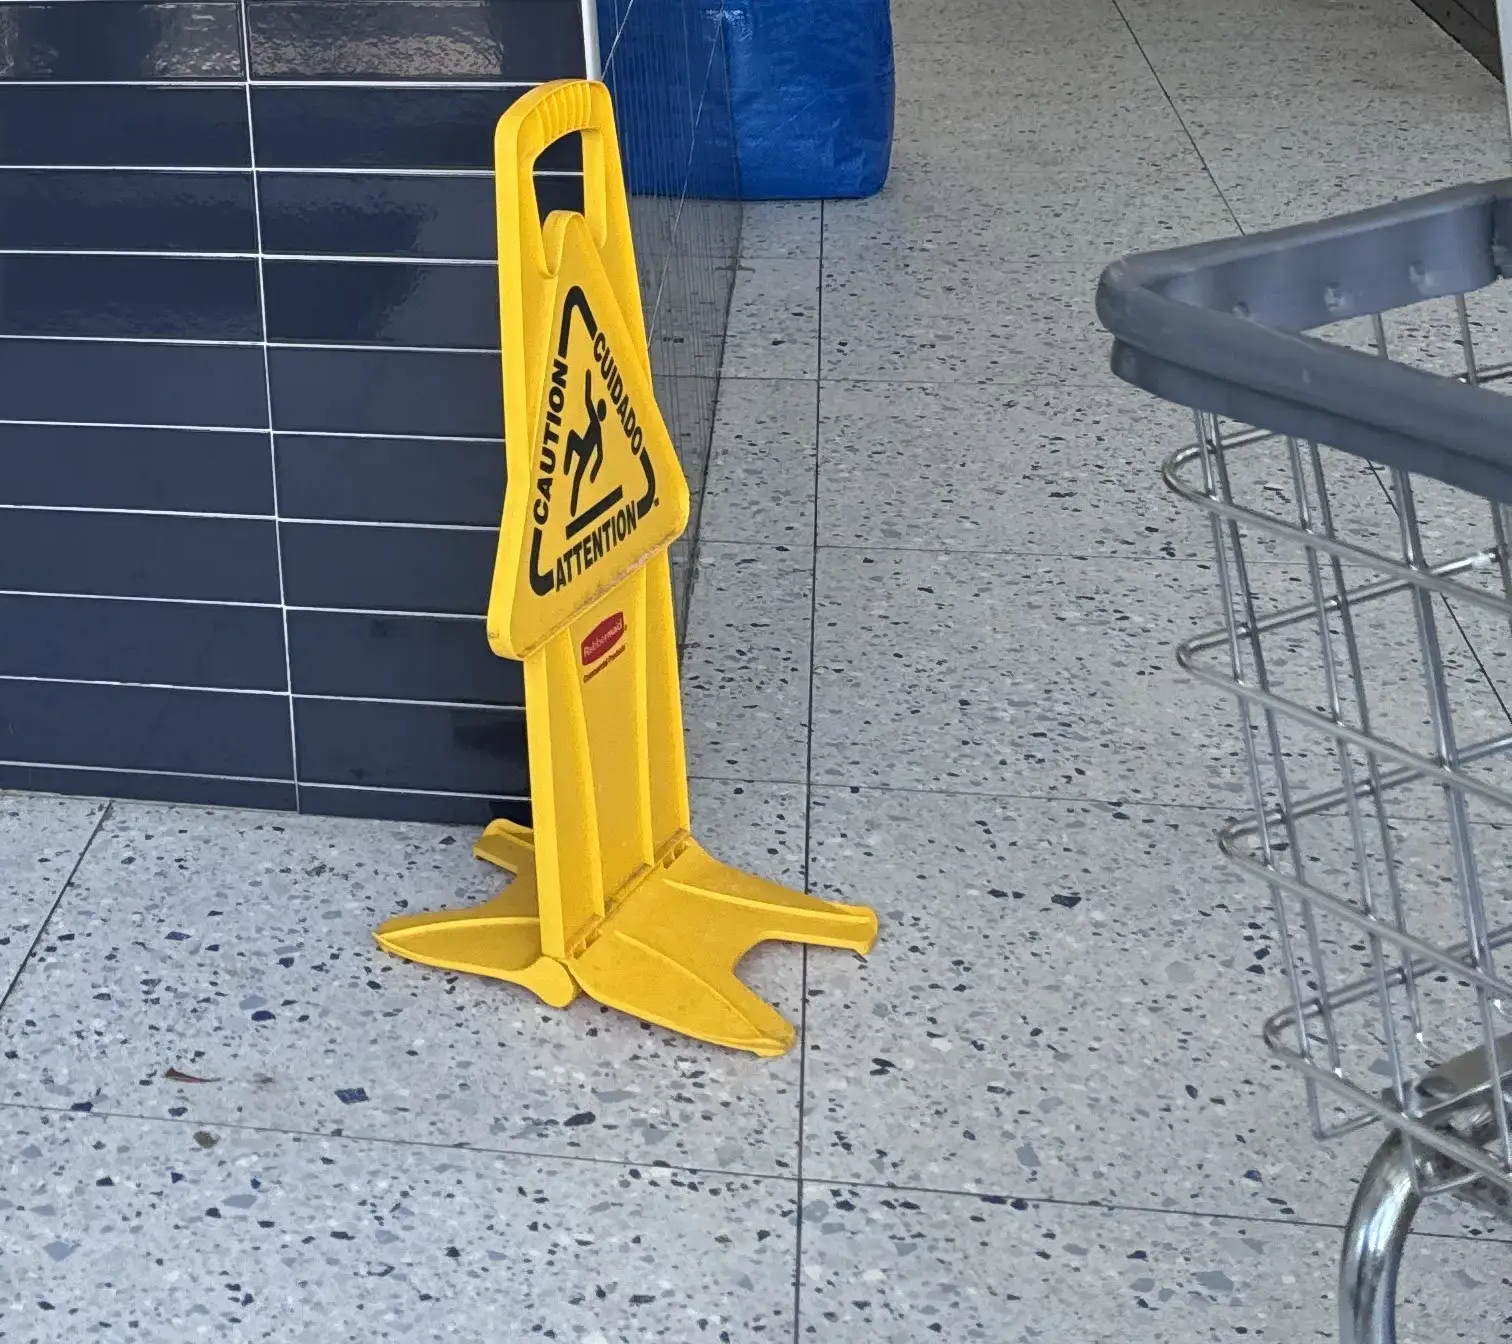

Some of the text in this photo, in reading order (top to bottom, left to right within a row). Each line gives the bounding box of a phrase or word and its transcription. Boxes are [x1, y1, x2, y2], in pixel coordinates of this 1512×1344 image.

[533, 358, 569, 525] CAUTION
[593, 332, 643, 456] CUIDADO
[555, 499, 638, 593] ATTENTION
